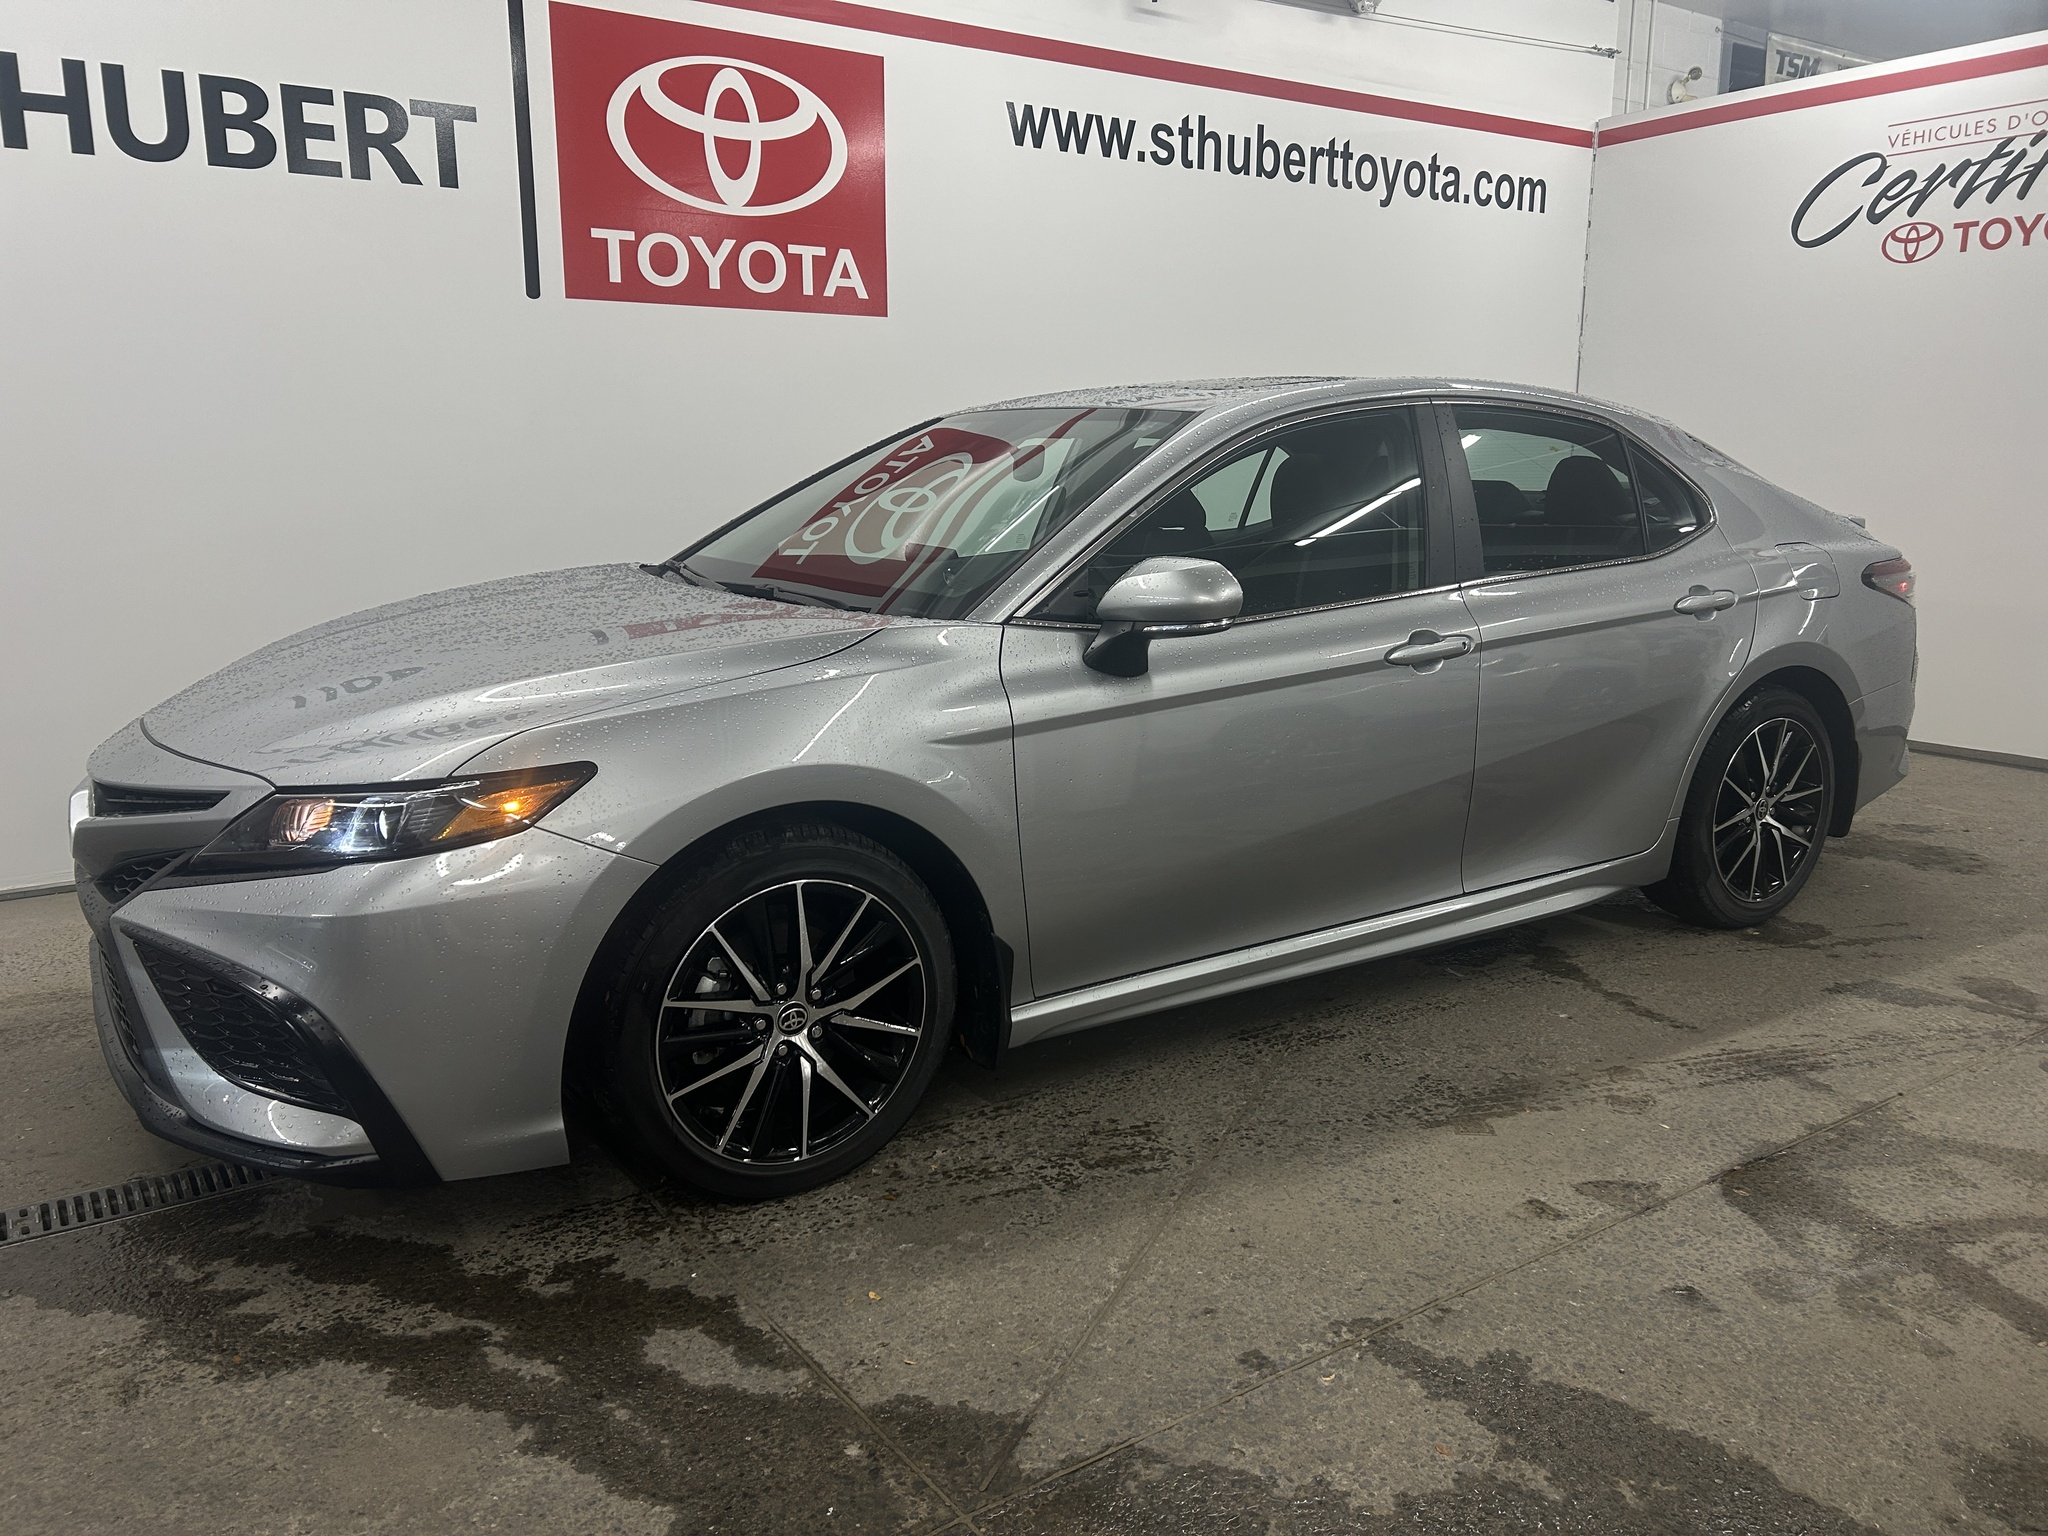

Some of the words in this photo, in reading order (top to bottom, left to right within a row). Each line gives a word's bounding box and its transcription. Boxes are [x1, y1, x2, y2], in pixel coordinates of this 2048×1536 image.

[1775, 49, 1822, 79] TSM
[0, 50, 478, 190] HUBERT
[1887, 118, 1997, 149] VÉHICULES
[1005, 101, 1548, 214] www.sthuberttoyota.com
[1953, 212, 2048, 253] TOY
[590, 227, 870, 300] TOYOTA
